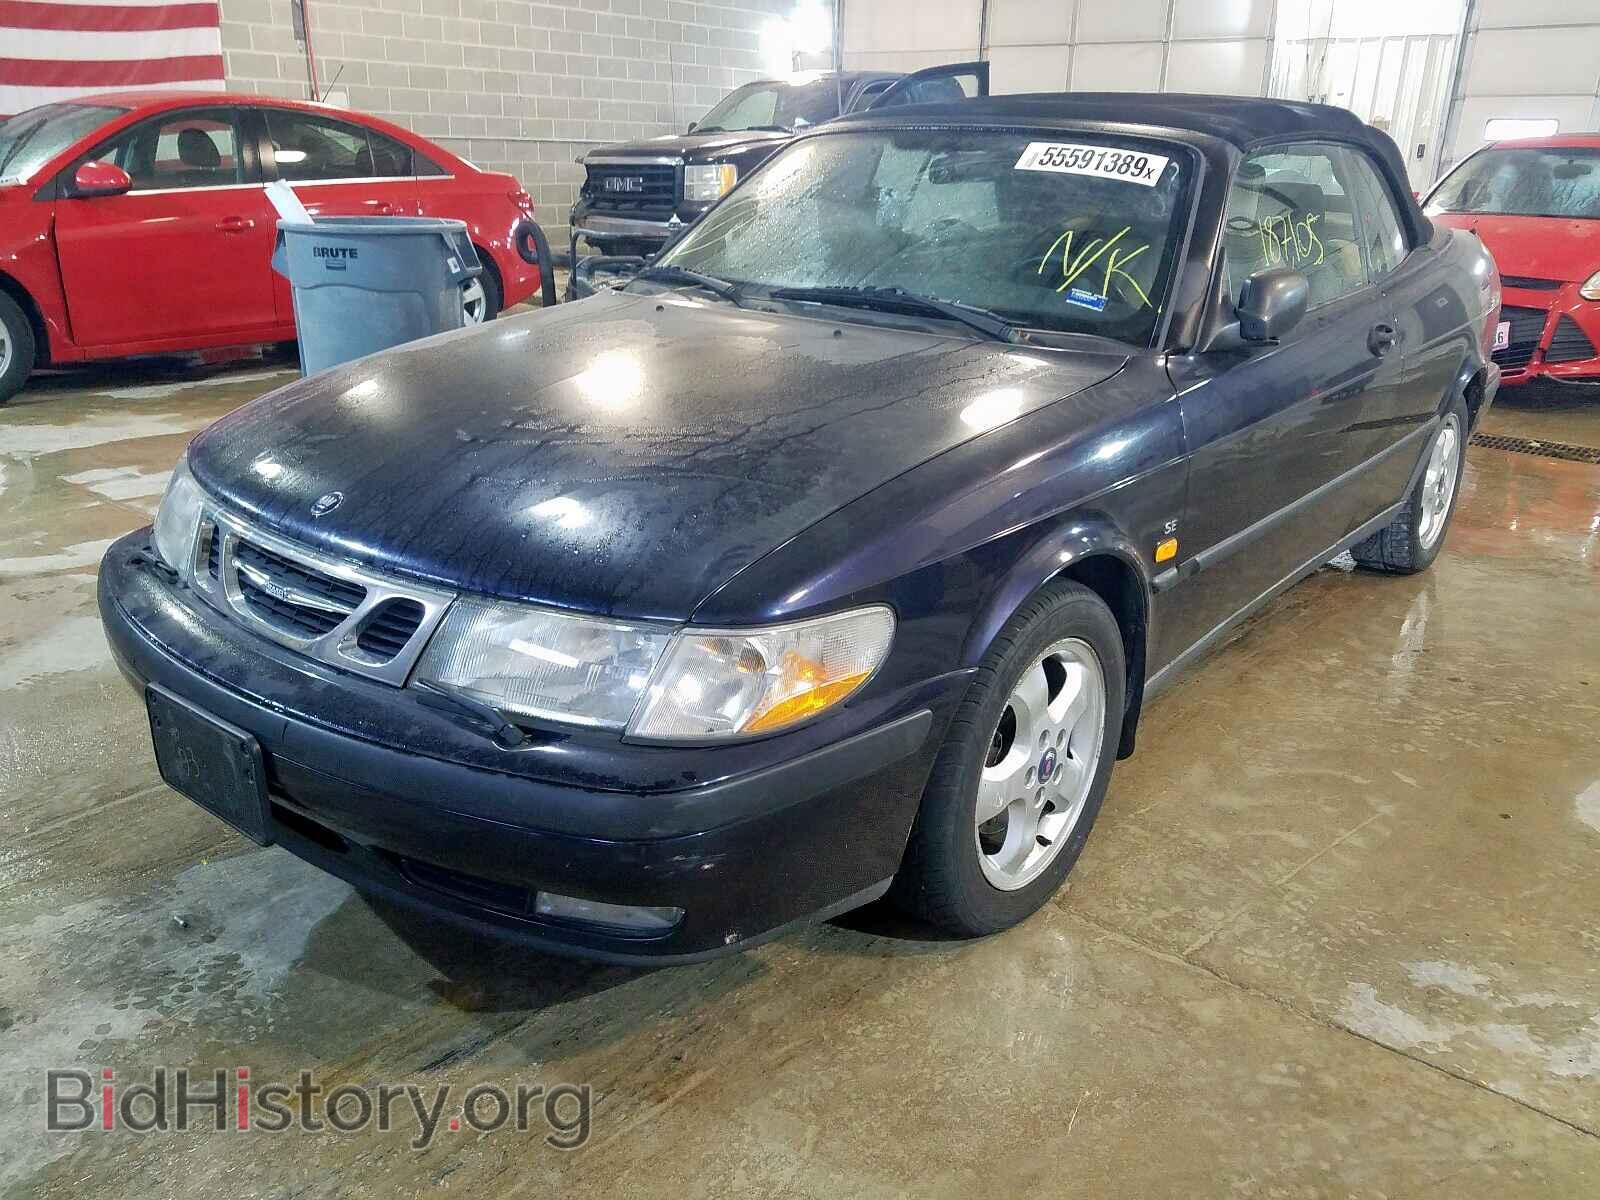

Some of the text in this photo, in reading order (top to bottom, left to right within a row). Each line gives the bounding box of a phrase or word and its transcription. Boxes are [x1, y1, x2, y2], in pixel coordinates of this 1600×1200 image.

[605, 176, 643, 192] GMC
[312, 246, 359, 259] BRUTE
[1038, 226, 1154, 308] N/K
[1164, 519, 1179, 535] SE
